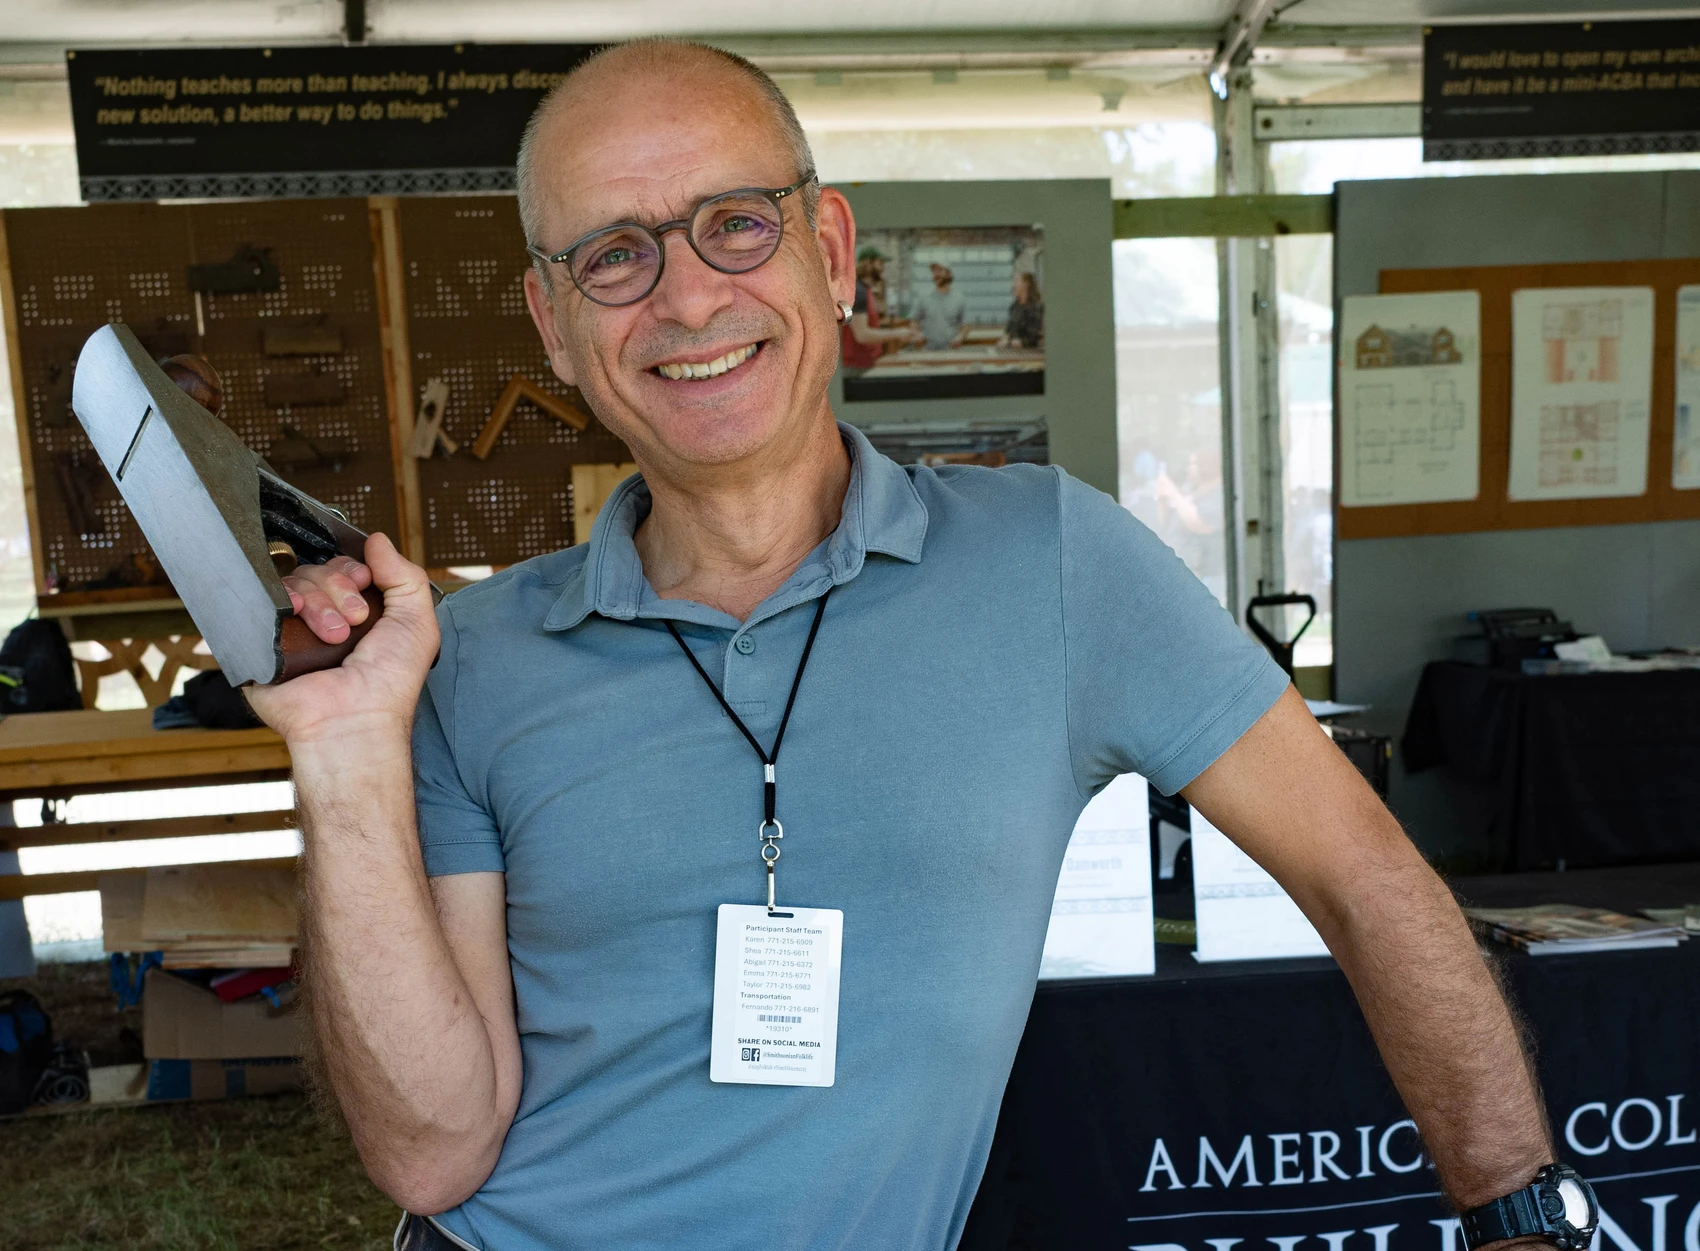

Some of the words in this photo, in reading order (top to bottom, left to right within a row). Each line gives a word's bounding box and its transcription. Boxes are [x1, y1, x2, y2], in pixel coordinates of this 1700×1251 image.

[1458, 50, 1506, 69] would
[1508, 49, 1541, 68] love
[1543, 49, 1559, 67] to
[1562, 50, 1600, 71] open
[1602, 50, 1627, 69] my
[1629, 48, 1661, 65] own
[94, 76, 176, 99] “Nothing
[181, 74, 252, 95] teaches
[256, 77, 303, 93] more
[307, 73, 347, 93] than
[352, 71, 433, 95] teaching.
[437, 71, 444, 88] I
[447, 70, 508, 93] always
[512, 69, 567, 88] disco
[1441, 76, 1471, 96] and
[1473, 76, 1510, 95] have
[1512, 76, 1524, 93] it
[1526, 74, 1547, 93] be
[1548, 77, 1559, 93] a
[1645, 71, 1676, 89] that
[97, 108, 135, 125] new
[140, 103, 219, 126] solution,
[223, 107, 235, 123] a
[239, 102, 292, 123] better
[297, 105, 333, 126] way
[337, 101, 356, 120] to
[359, 101, 383, 120] do
[745, 924, 784, 933] Participant
[785, 926, 802, 934] Staff
[803, 927, 823, 935] Team
[767, 936, 813, 946] 771-215-6909
[744, 946, 762, 954] Shea
[764, 947, 810, 957] 771-215-6611
[743, 958, 766, 967] Abigail
[743, 969, 765, 977] Emma
[766, 970, 811, 979] 771-215-6771
[743, 980, 763, 989] Taylor
[740, 992, 792, 1001] Transportation
[741, 1003, 773, 1011] Fernando
[737, 1037, 760, 1045] SHARE
[773, 1039, 797, 1047] SOCIAL
[799, 1040, 821, 1048] MEDIA
[1138, 1119, 1436, 1192] AMERIC
[1565, 1093, 1699, 1156] COL
